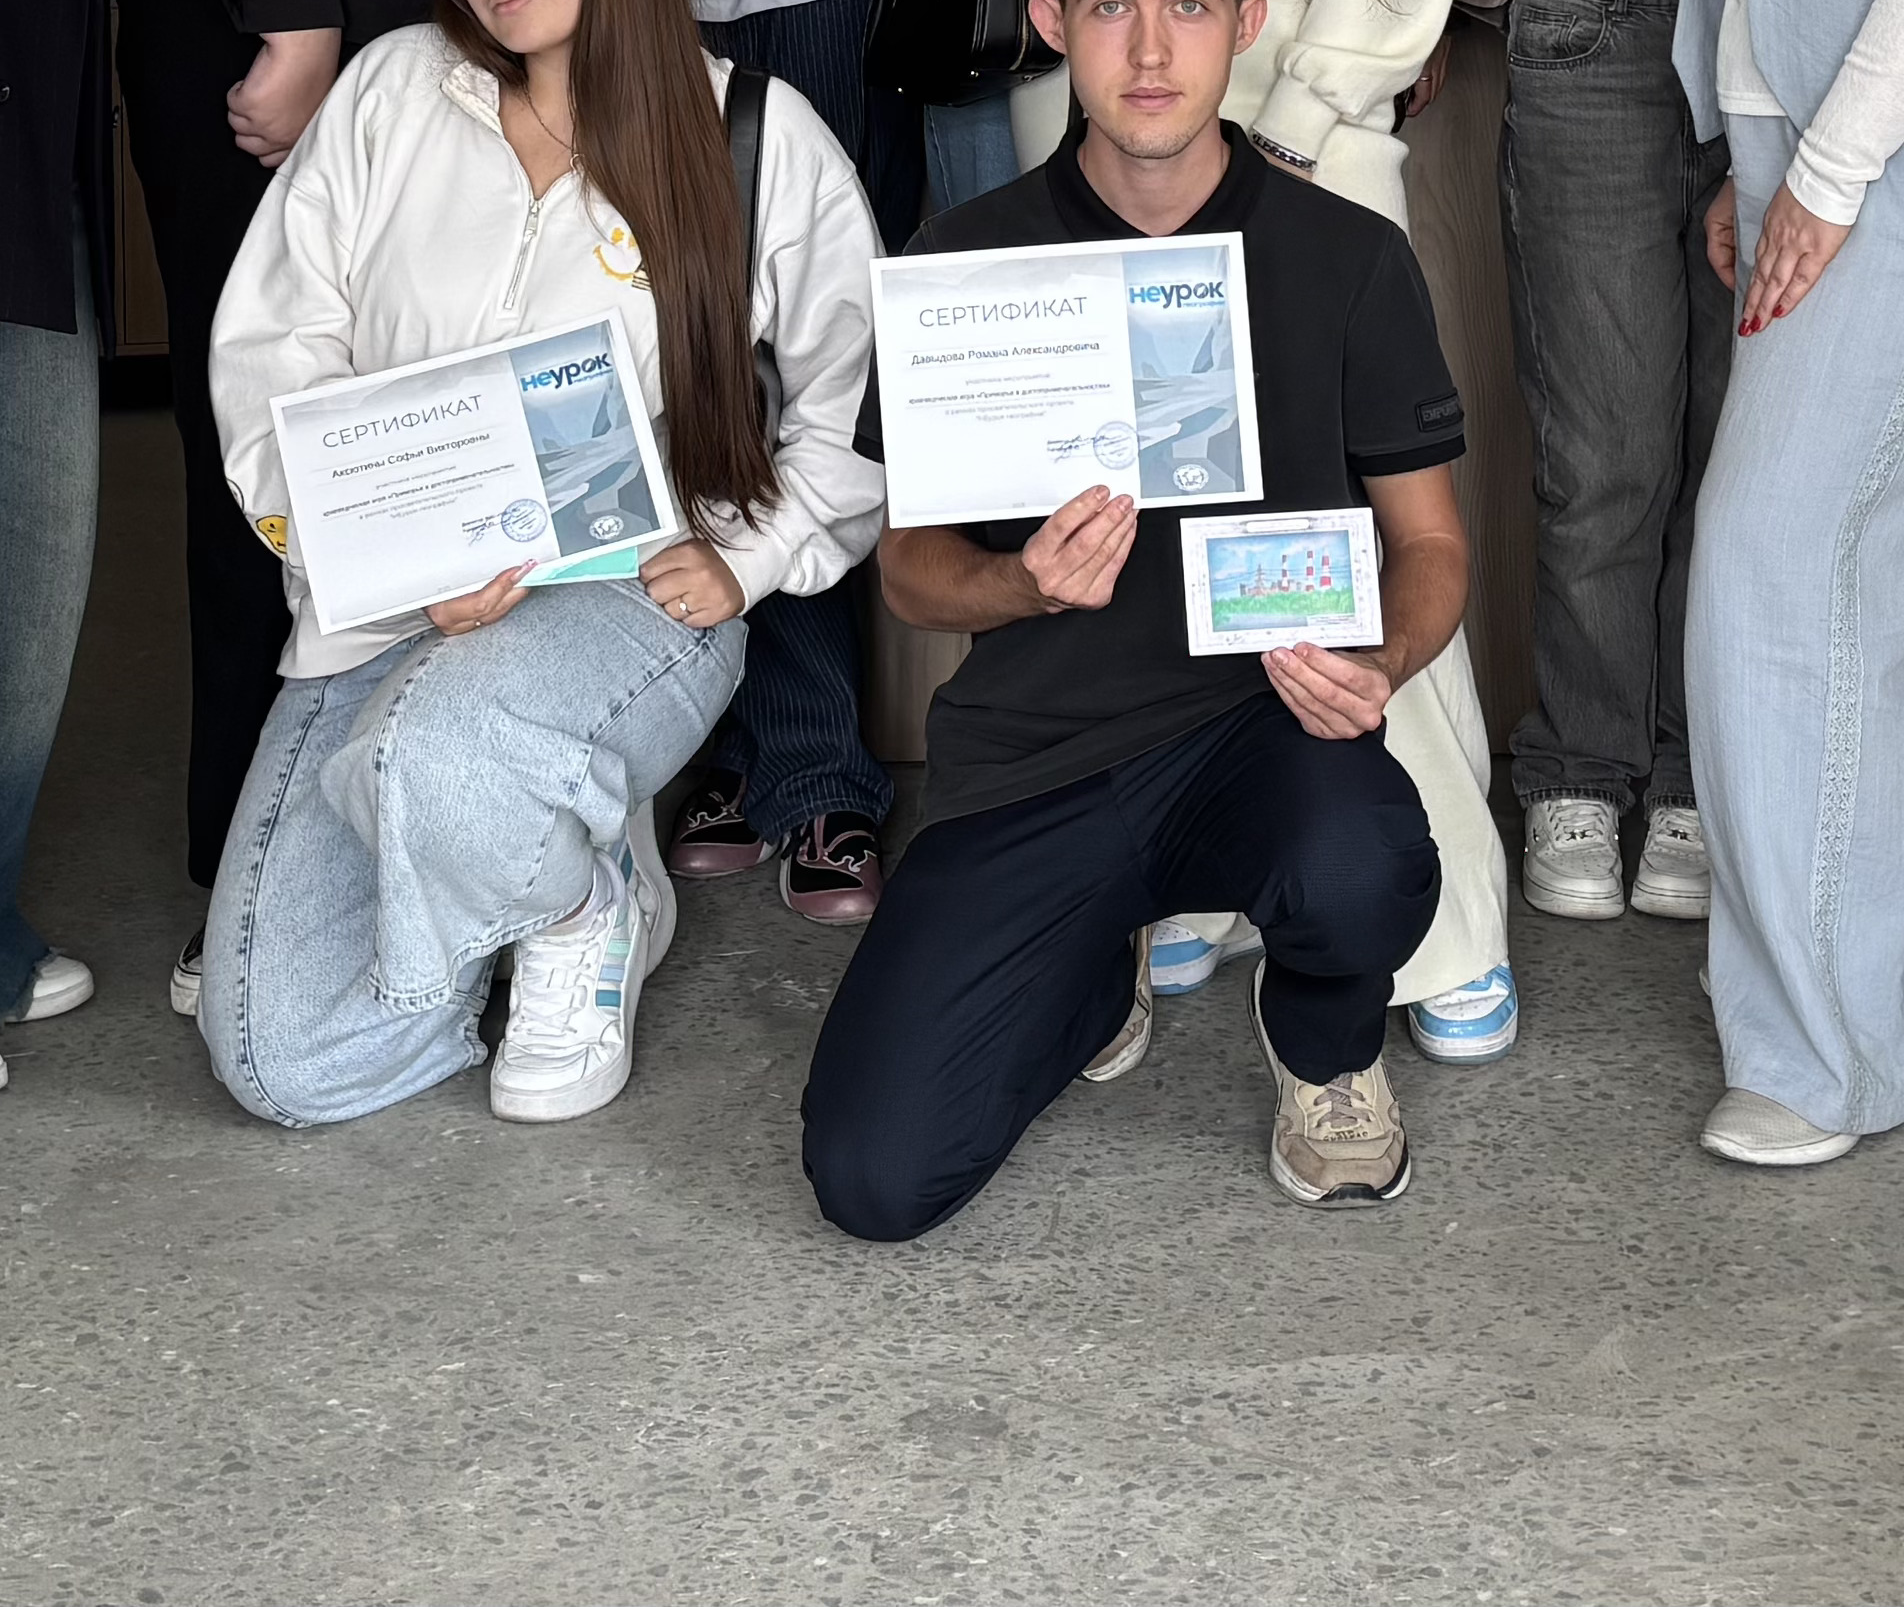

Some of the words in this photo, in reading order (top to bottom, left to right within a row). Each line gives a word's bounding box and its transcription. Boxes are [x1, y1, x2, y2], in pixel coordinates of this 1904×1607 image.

[1127, 280, 1224, 310] неурок
[918, 296, 1088, 328] СЕРТИФИКАТ
[968, 347, 1009, 360] Романа
[519, 351, 613, 393] неурок
[322, 394, 483, 449] СЕРТИФИКАТ
